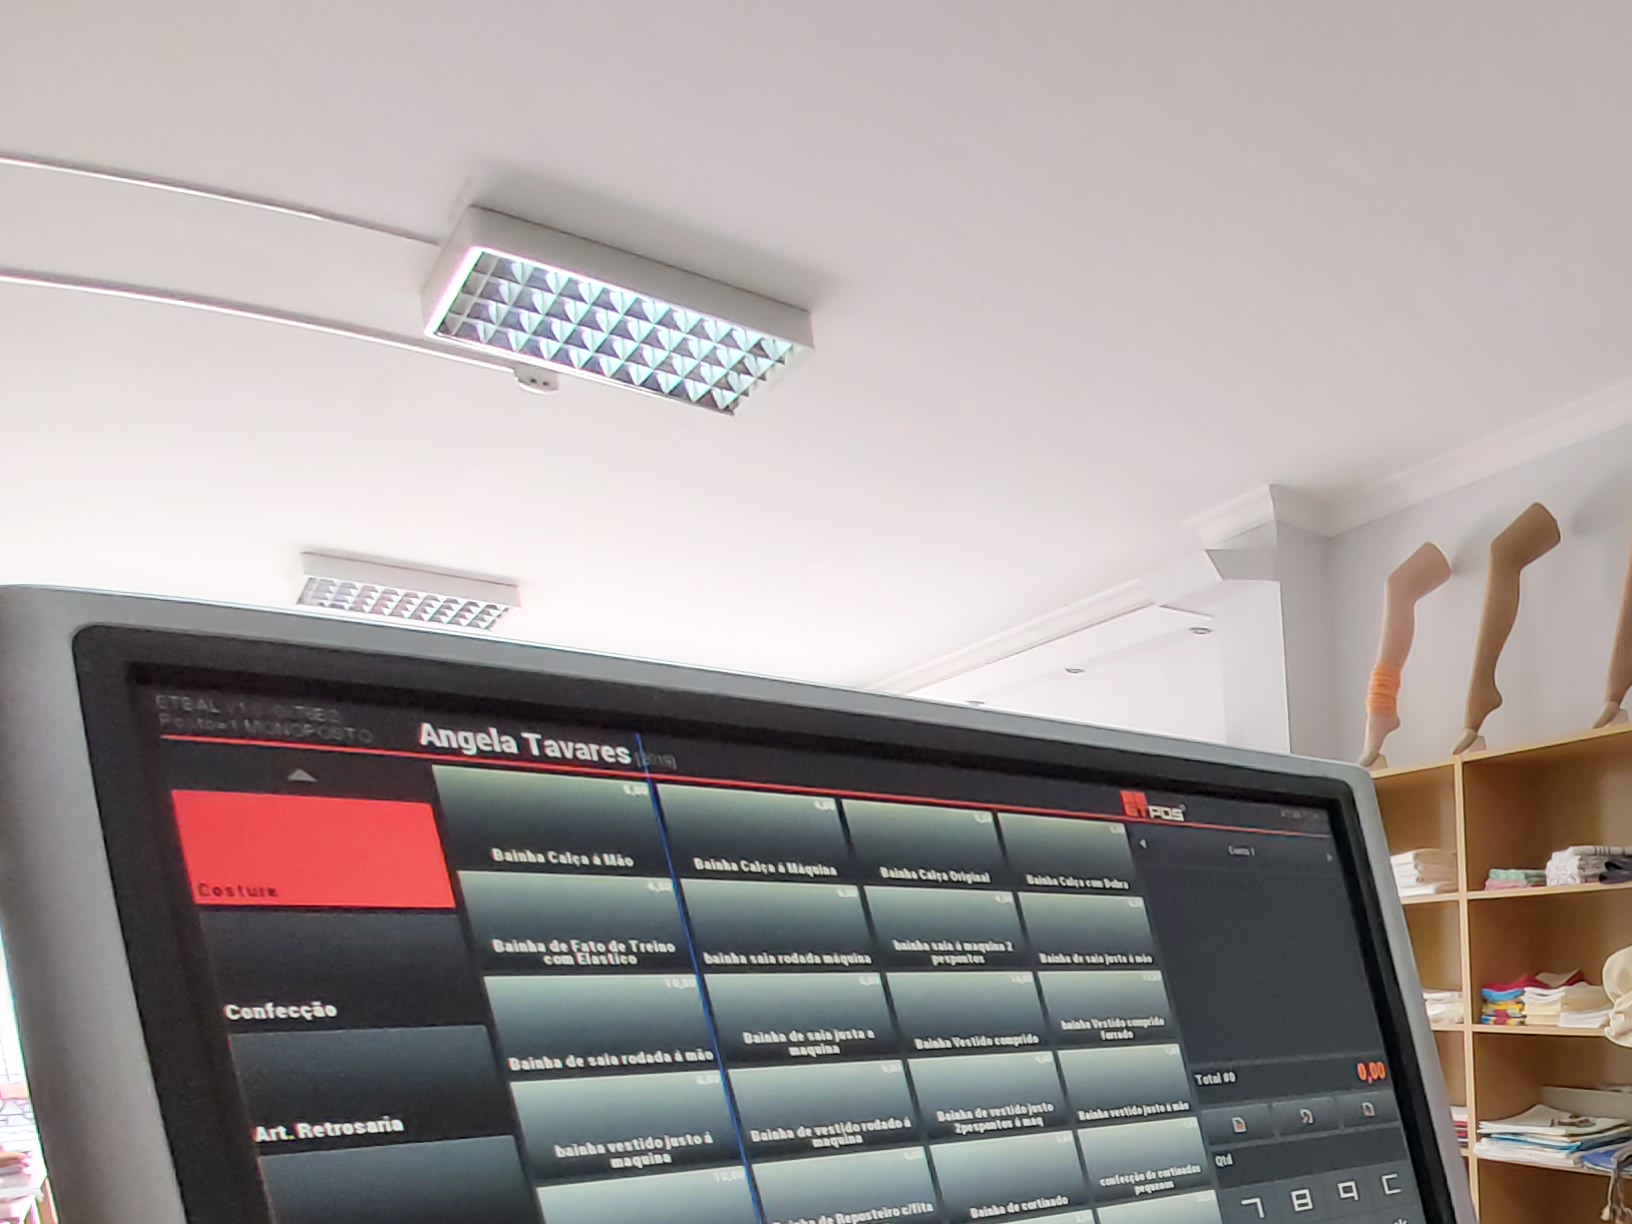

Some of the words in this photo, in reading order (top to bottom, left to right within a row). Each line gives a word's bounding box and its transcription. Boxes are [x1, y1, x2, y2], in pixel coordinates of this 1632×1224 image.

[419, 722, 518, 755] Angela
[521, 732, 632, 766] Tavares
[1147, 805, 1186, 822] POS
[491, 847, 546, 864] Bainha
[547, 850, 590, 866] Calça
[603, 852, 635, 867] Mão
[694, 857, 740, 872] Bainha
[740, 859, 776, 876] Calça
[879, 866, 918, 881] Bainha
[918, 868, 949, 884] Calça
[949, 870, 991, 885] Original
[492, 939, 547, 954] Bainha
[549, 939, 569, 954] de
[570, 940, 607, 954] Fato
[608, 940, 627, 954] de
[628, 940, 677, 954] Treino
[543, 954, 576, 966] com
[576, 952, 638, 966] Elastico
[703, 952, 748, 966] bainha
[750, 953, 777, 965] saia
[778, 952, 822, 966] rodada
[223, 1000, 338, 1021] Confecção
[743, 1030, 788, 1045] Bainha
[789, 1030, 805, 1043] de
[806, 1029, 832, 1043] saia
[832, 1029, 866, 1044] justa
[914, 1037, 952, 1051] Bainha
[993, 1033, 1040, 1048] comprido
[788, 1043, 841, 1058] maquina
[508, 1055, 564, 1072] Bainha
[565, 1053, 584, 1069] de
[587, 1053, 620, 1067] saia
[620, 1050, 673, 1066] rodada
[684, 1048, 715, 1062] mão
[1194, 1071, 1223, 1086] Total
[1356, 1060, 1388, 1085] 0,00
[936, 1109, 975, 1123] Bainha
[975, 1107, 988, 1120] de
[252, 1124, 296, 1144] Art.
[295, 1114, 405, 1139] Retrosaria
[751, 1127, 796, 1143] Bainha
[796, 1125, 813, 1138] de
[813, 1120, 861, 1137] vestido
[860, 1117, 903, 1132] rodado
[554, 1141, 606, 1158] bainha
[607, 1136, 664, 1153] vestido
[664, 1133, 702, 1151] justo
[812, 1133, 864, 1150] maquina
[609, 1152, 672, 1170] maquina
[1214, 1152, 1234, 1168] Qtd
[1240, 1196, 1266, 1219] 7
[1290, 1188, 1314, 1212] 8
[1336, 1180, 1360, 1201] 9
[1380, 1173, 1403, 1196] C
[969, 1204, 1007, 1219] Bainha
[1006, 1202, 1020, 1215] de
[1021, 1194, 1069, 1213] cortinado
